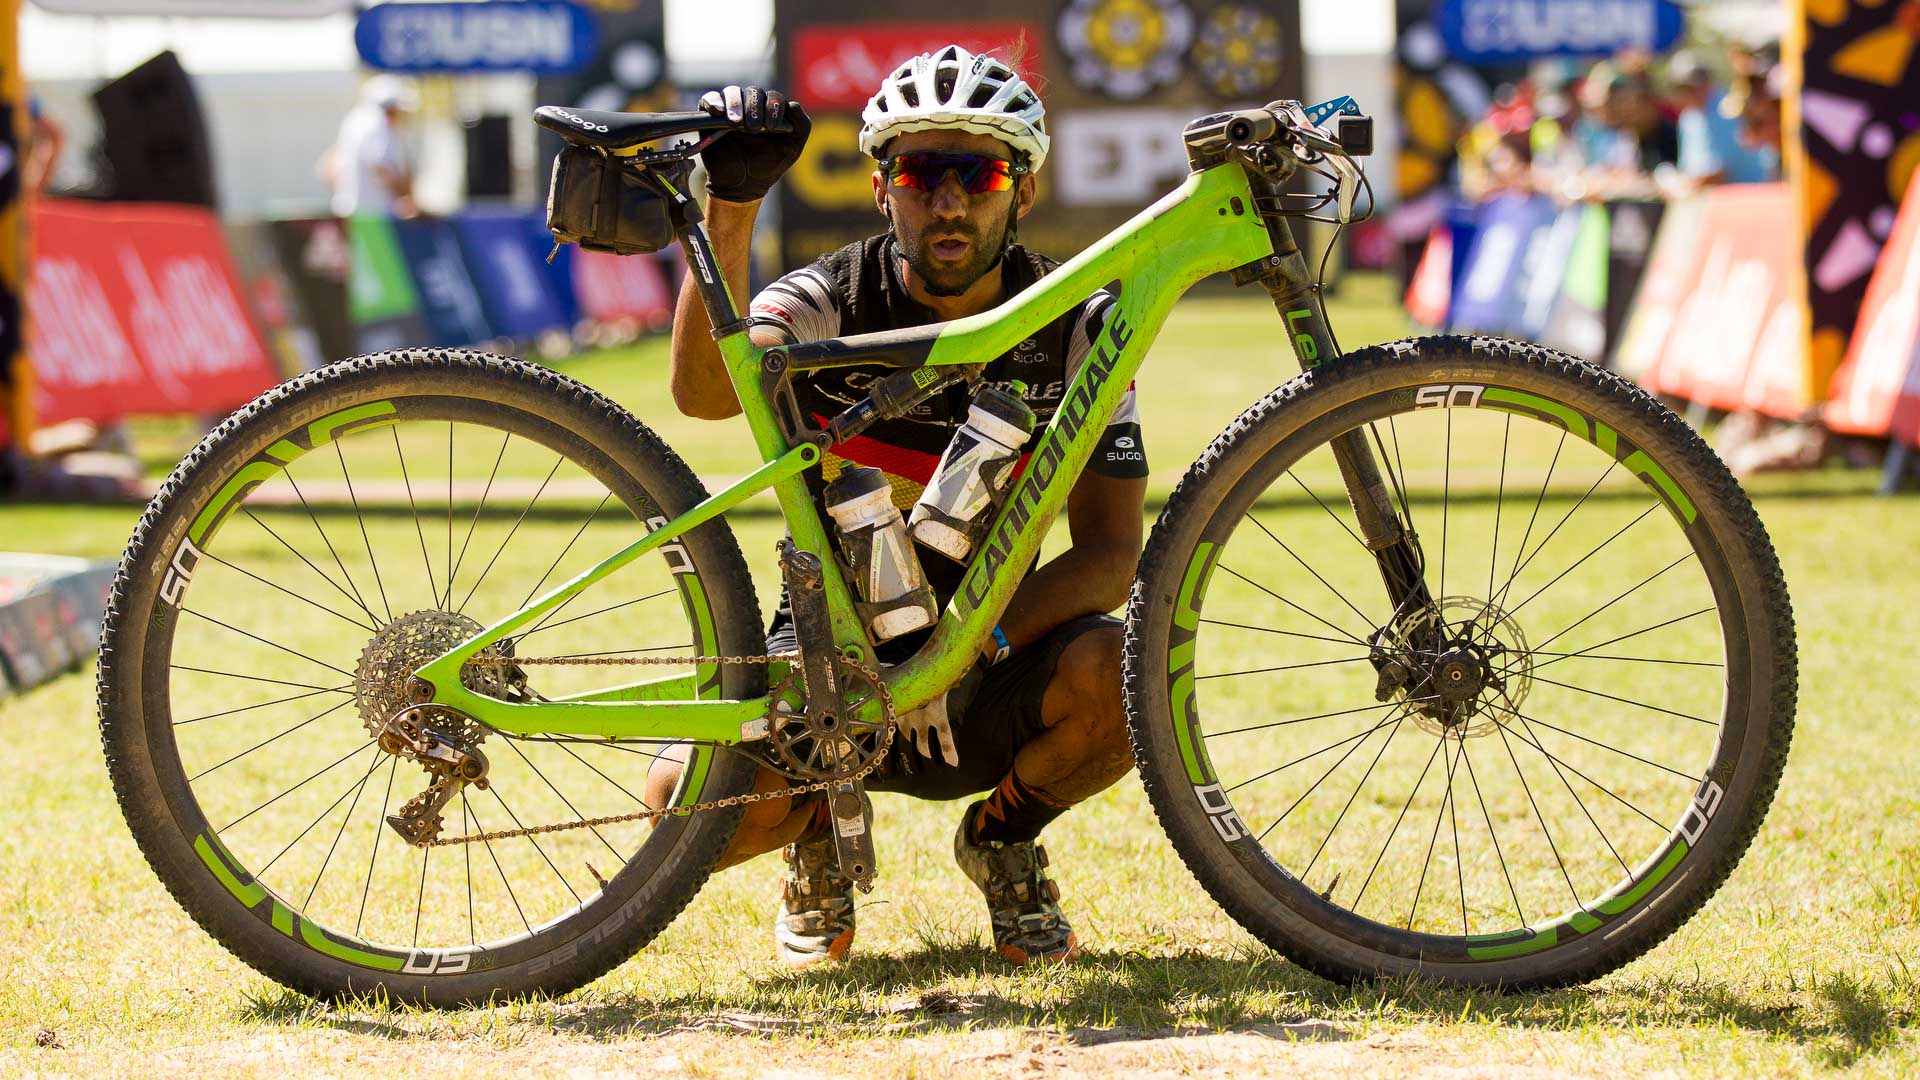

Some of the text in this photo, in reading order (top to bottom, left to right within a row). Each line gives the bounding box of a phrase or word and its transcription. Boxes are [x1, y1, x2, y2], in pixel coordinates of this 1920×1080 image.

[551, 107, 609, 133] ologo
[1415, 385, 1485, 411] 50
[159, 536, 204, 611] 50
[1193, 783, 1250, 843] 50
[1676, 774, 1725, 849] 50
[401, 953, 470, 975] 50
